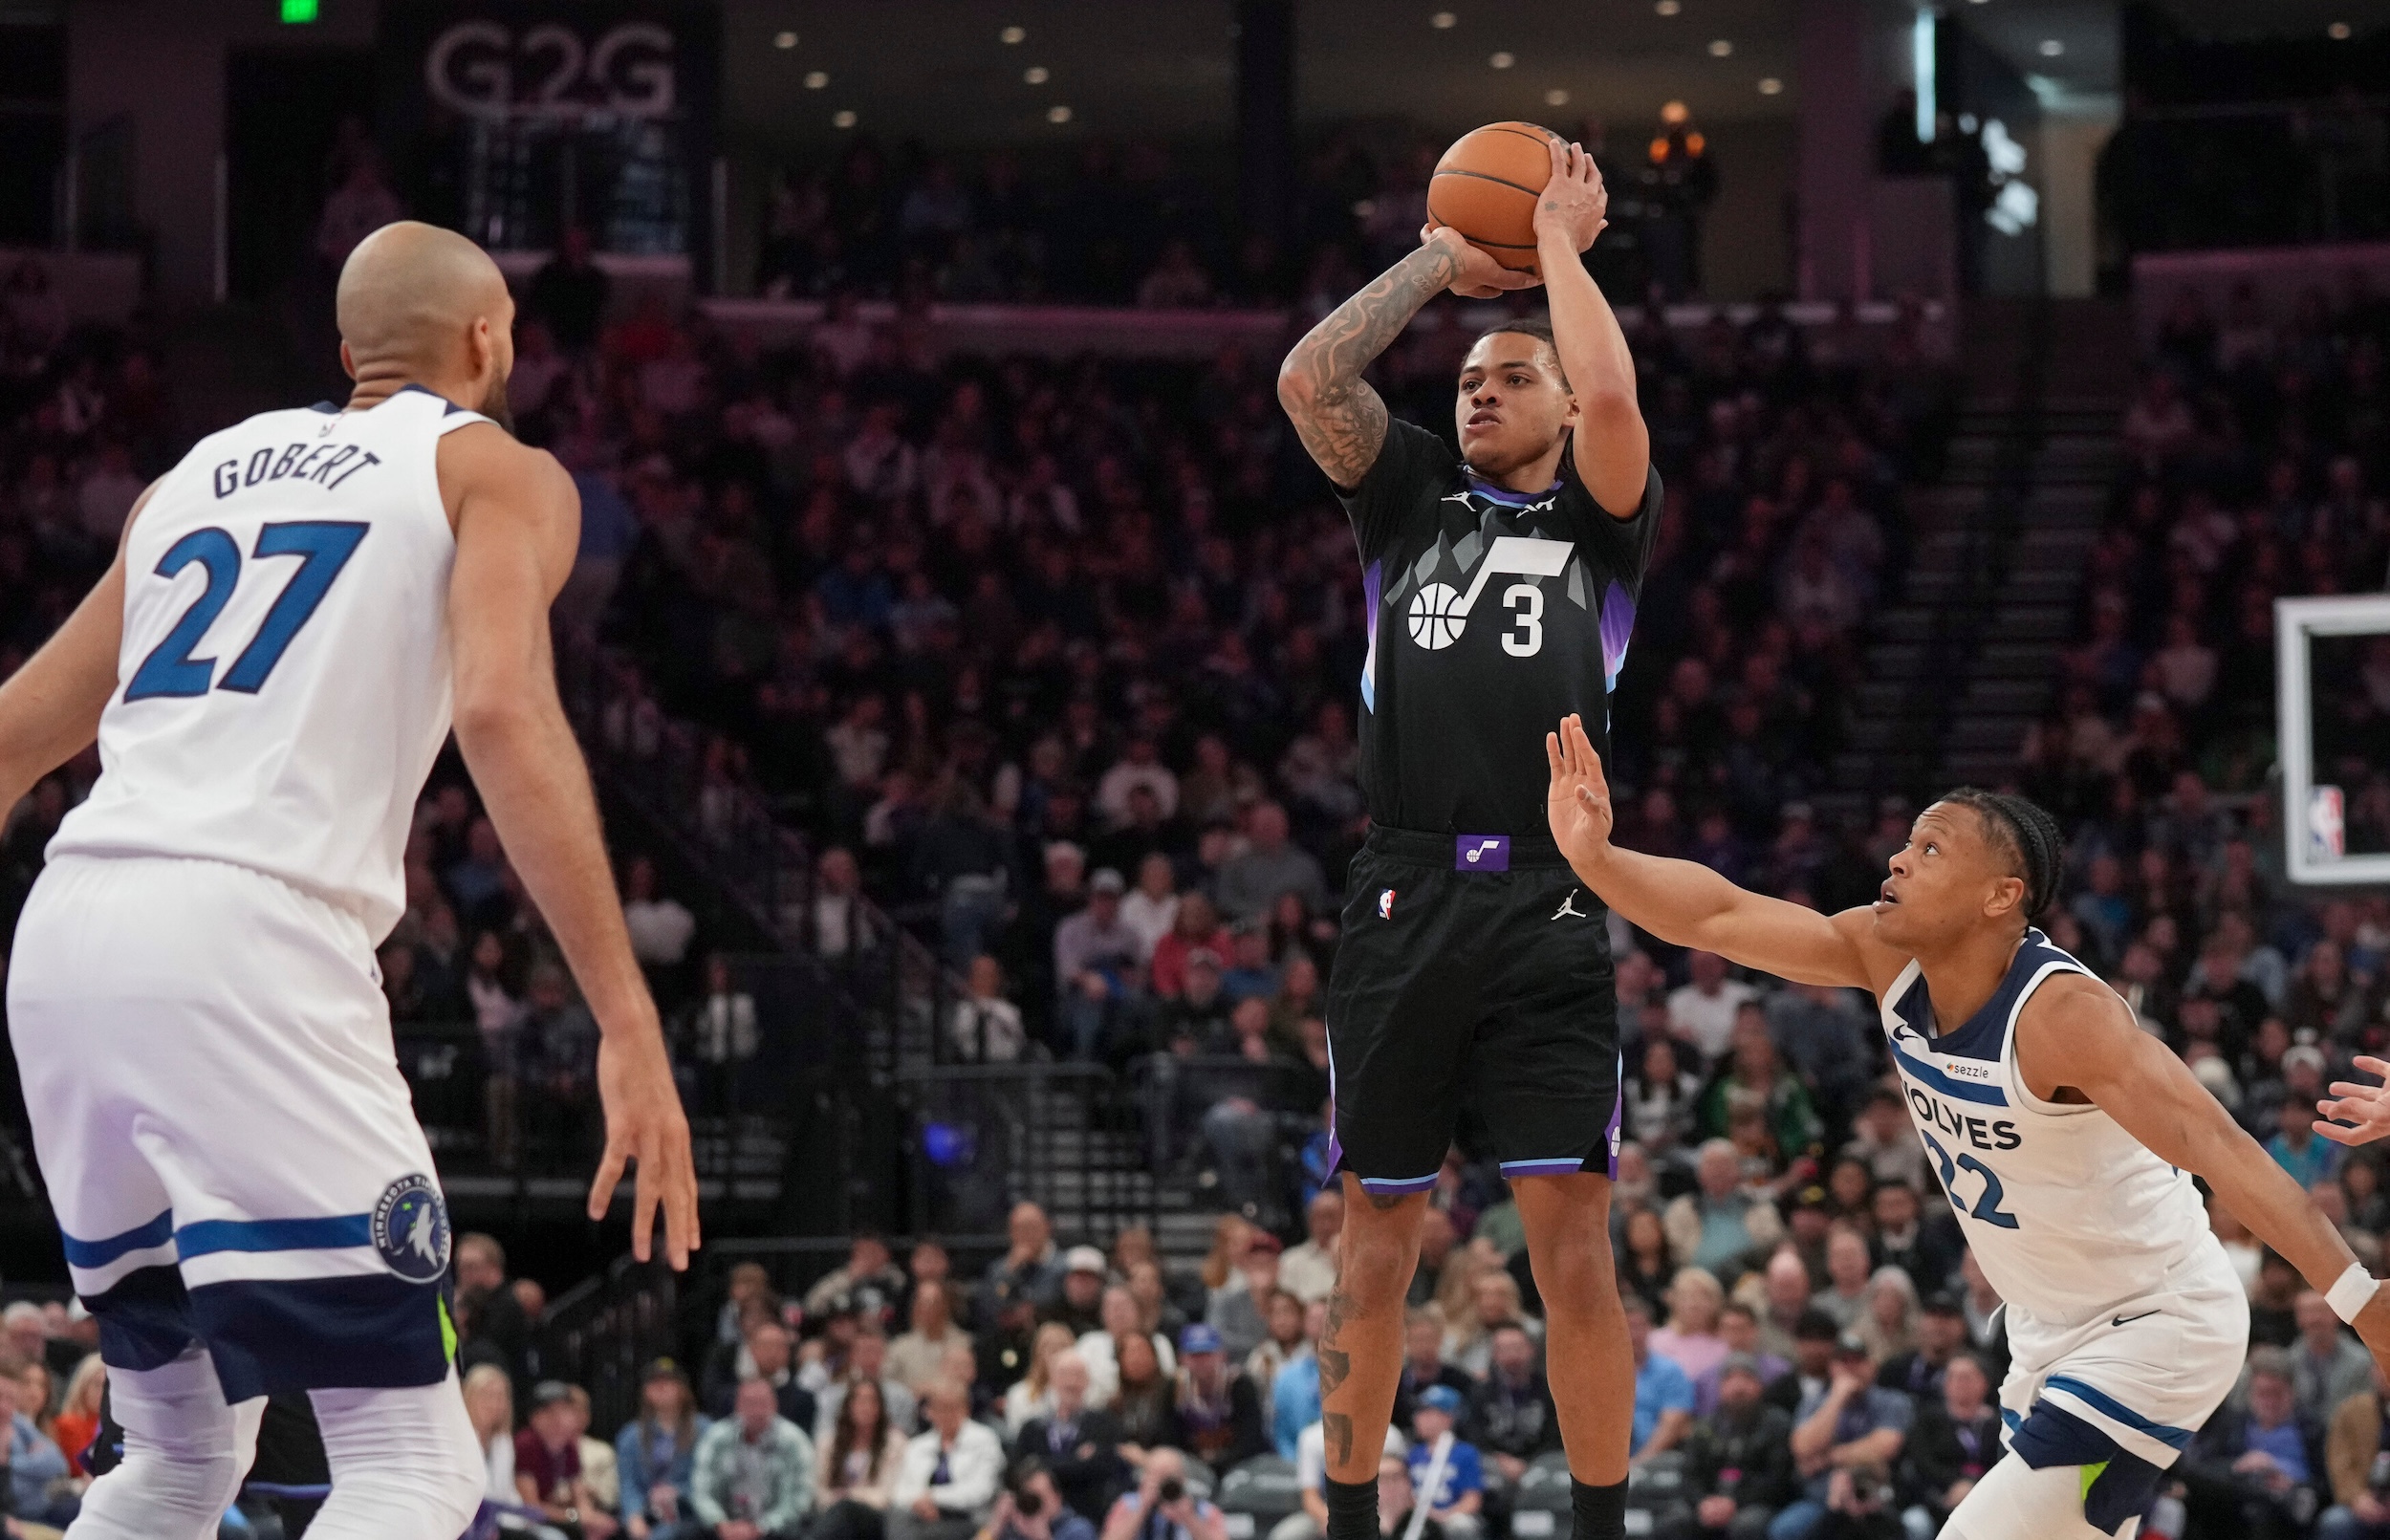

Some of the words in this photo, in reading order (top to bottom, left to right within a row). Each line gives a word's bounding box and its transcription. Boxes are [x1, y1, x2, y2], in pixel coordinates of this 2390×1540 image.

[427, 19, 675, 119] G2G
[214, 444, 380, 500] GOBERT
[122, 520, 371, 705] 27
[1501, 583, 1545, 658] 3
[1953, 1065, 1989, 1078] sezzle
[375, 1179, 412, 1248] MINNESOTA
[1921, 1128, 2020, 1229] 22
